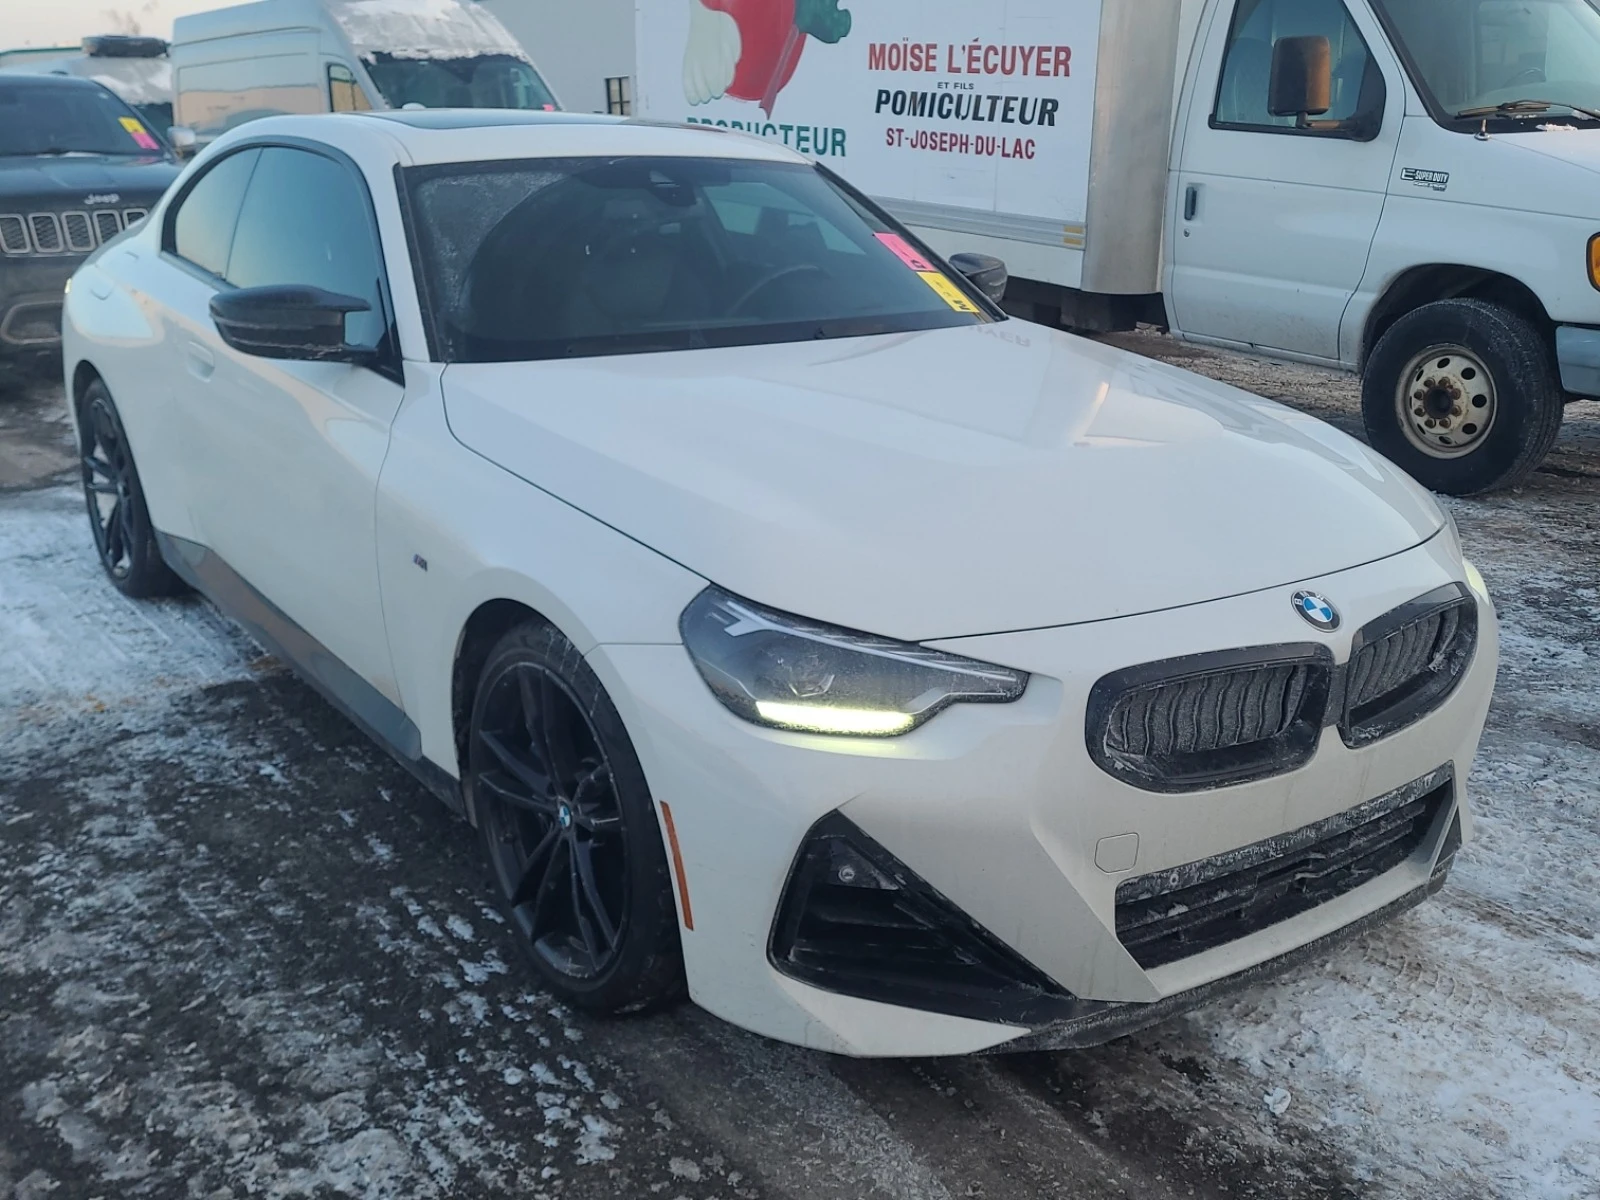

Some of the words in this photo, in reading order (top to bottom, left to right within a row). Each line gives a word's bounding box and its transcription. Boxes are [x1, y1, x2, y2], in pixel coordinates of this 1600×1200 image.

[868, 37, 938, 72] MOÏSE
[947, 37, 1072, 77] L'ÉCUYER
[937, 81, 949, 89] ET
[954, 82, 974, 90] FILS
[875, 89, 1059, 127] POMICULTEUR
[687, 117, 846, 157] CTEUR
[886, 127, 1036, 160] ST-JOSEPH-DU-LAC
